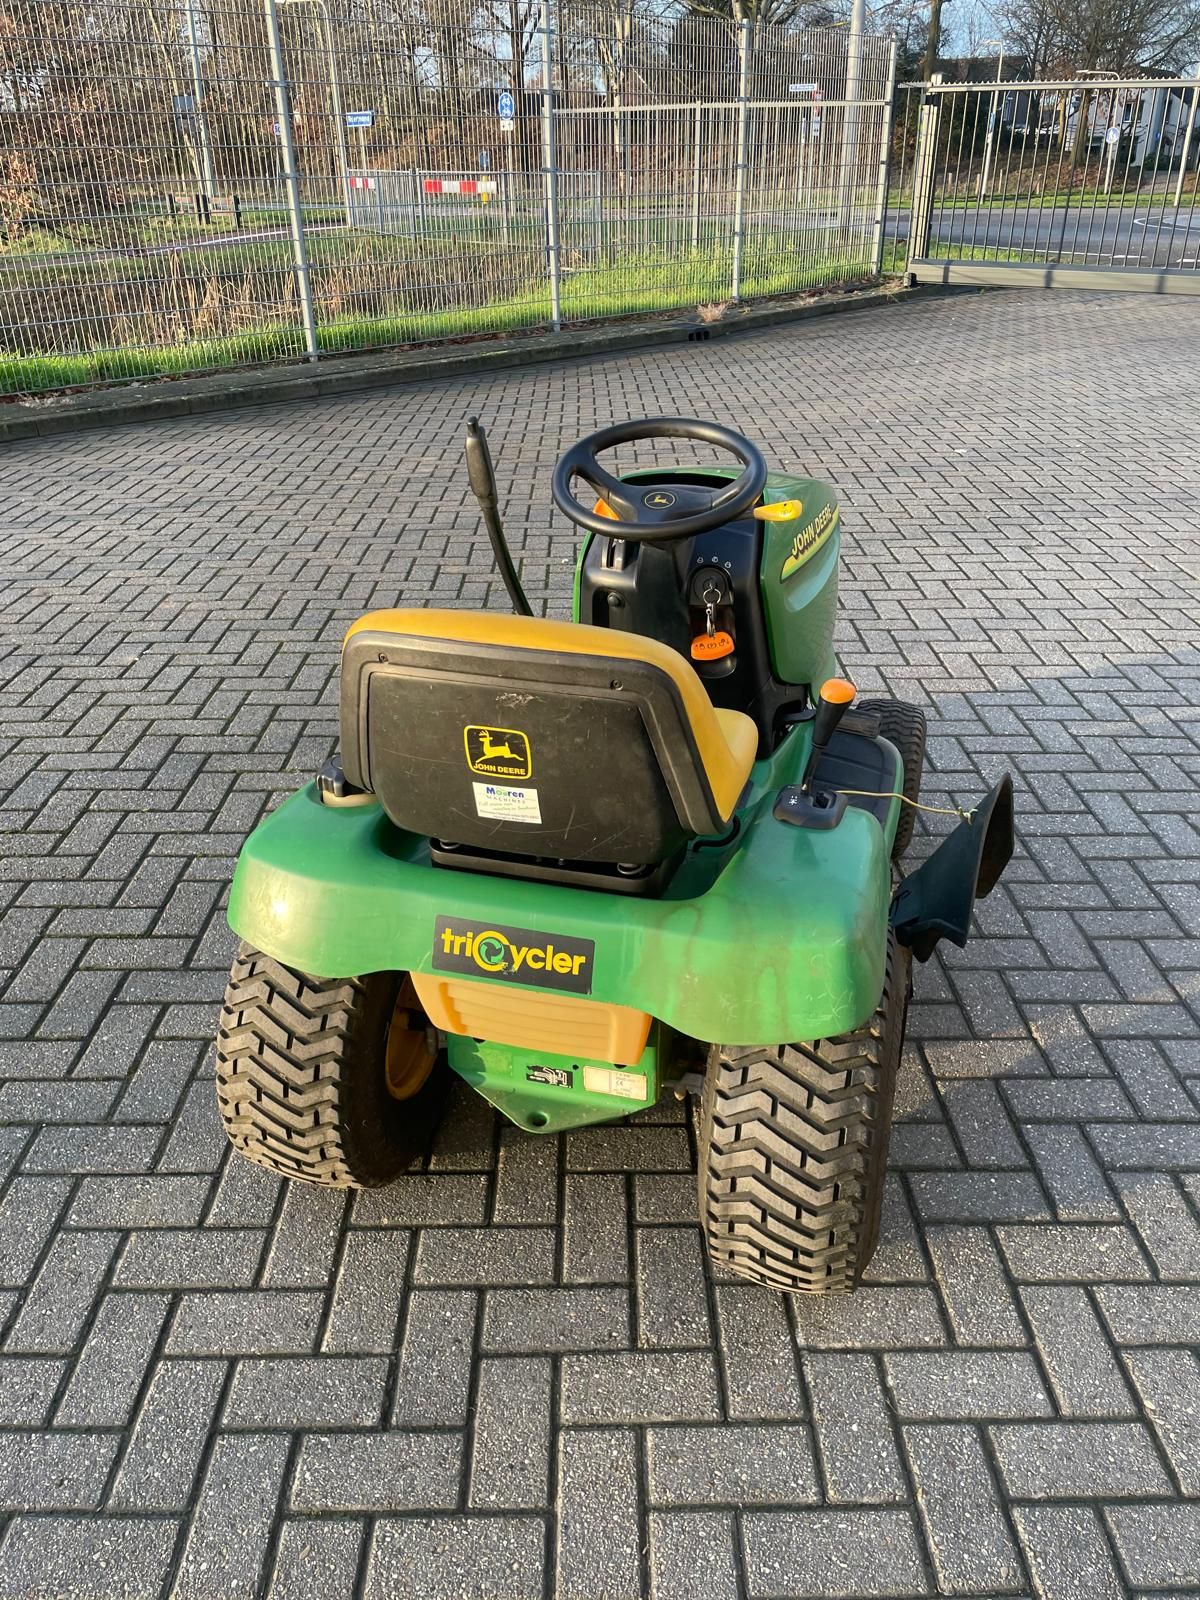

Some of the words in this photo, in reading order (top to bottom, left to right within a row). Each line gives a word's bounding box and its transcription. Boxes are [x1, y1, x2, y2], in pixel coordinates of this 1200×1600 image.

[791, 522, 815, 557] JOHN
[814, 503, 832, 535] DEERE
[473, 763, 496, 772] JOHN
[497, 766, 526, 776] DEERE
